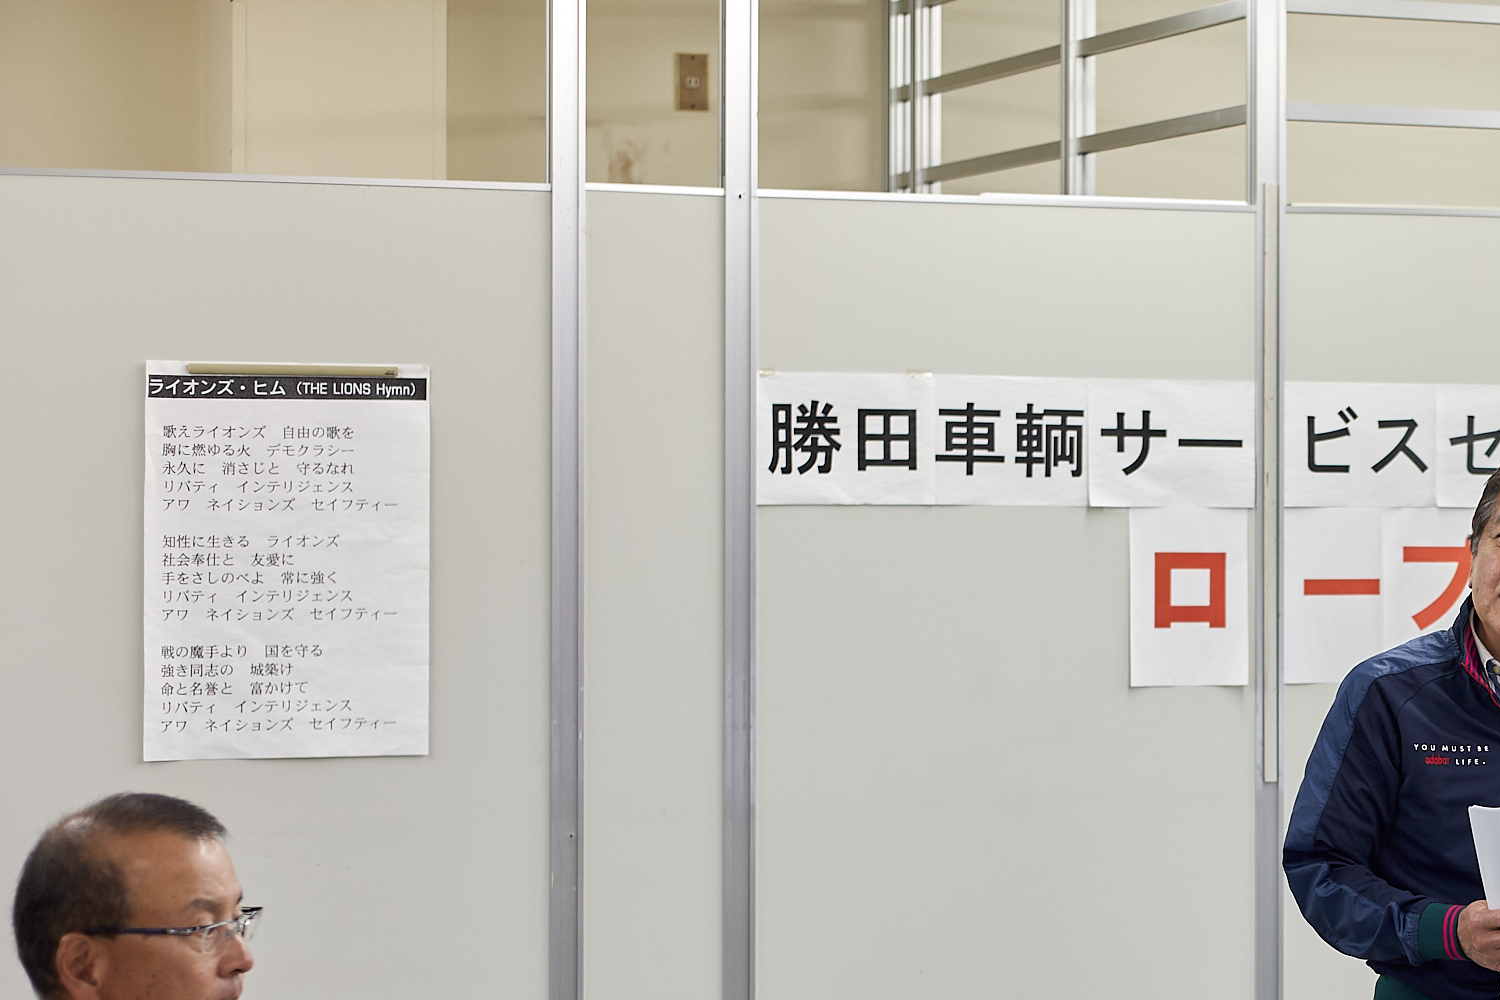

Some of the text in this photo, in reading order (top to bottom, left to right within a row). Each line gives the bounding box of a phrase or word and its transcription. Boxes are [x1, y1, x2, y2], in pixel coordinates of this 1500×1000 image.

[149, 378, 416, 398] ライオンズ・ヒム (THE LIONS Hymn)
[162, 425, 354, 440] 歌えライオンズ 自由の歌を
[161, 443, 355, 458] 胸に燃ゆる火 デモクラシー
[161, 461, 355, 476] 永久に 消さじと 守るなれ
[163, 480, 354, 494] リバティ インテリジェンス
[162, 498, 398, 512] アワ ネイションズ セイフティー
[162, 534, 341, 549] 知性に生きる ライオンズ
[161, 553, 294, 568] 社会奉仕と 友愛に
[161, 571, 337, 586] 手をさしのべよ 常に強く
[162, 590, 353, 604] リバティ インテリジェンス
[161, 607, 398, 622] アワ ネイションズ セイフティー
[161, 644, 323, 660] 戦の魔手より 国を守る
[160, 663, 294, 678] 強き同志の 城築け
[160, 681, 309, 697] 命と名誉と 富かけて
[161, 700, 352, 715] リバティ インテリジェンス
[160, 717, 397, 734] アワ ネイションズ セイフティー
[1413, 743, 1436, 751] YOU
[1441, 744, 1471, 752] MUST
